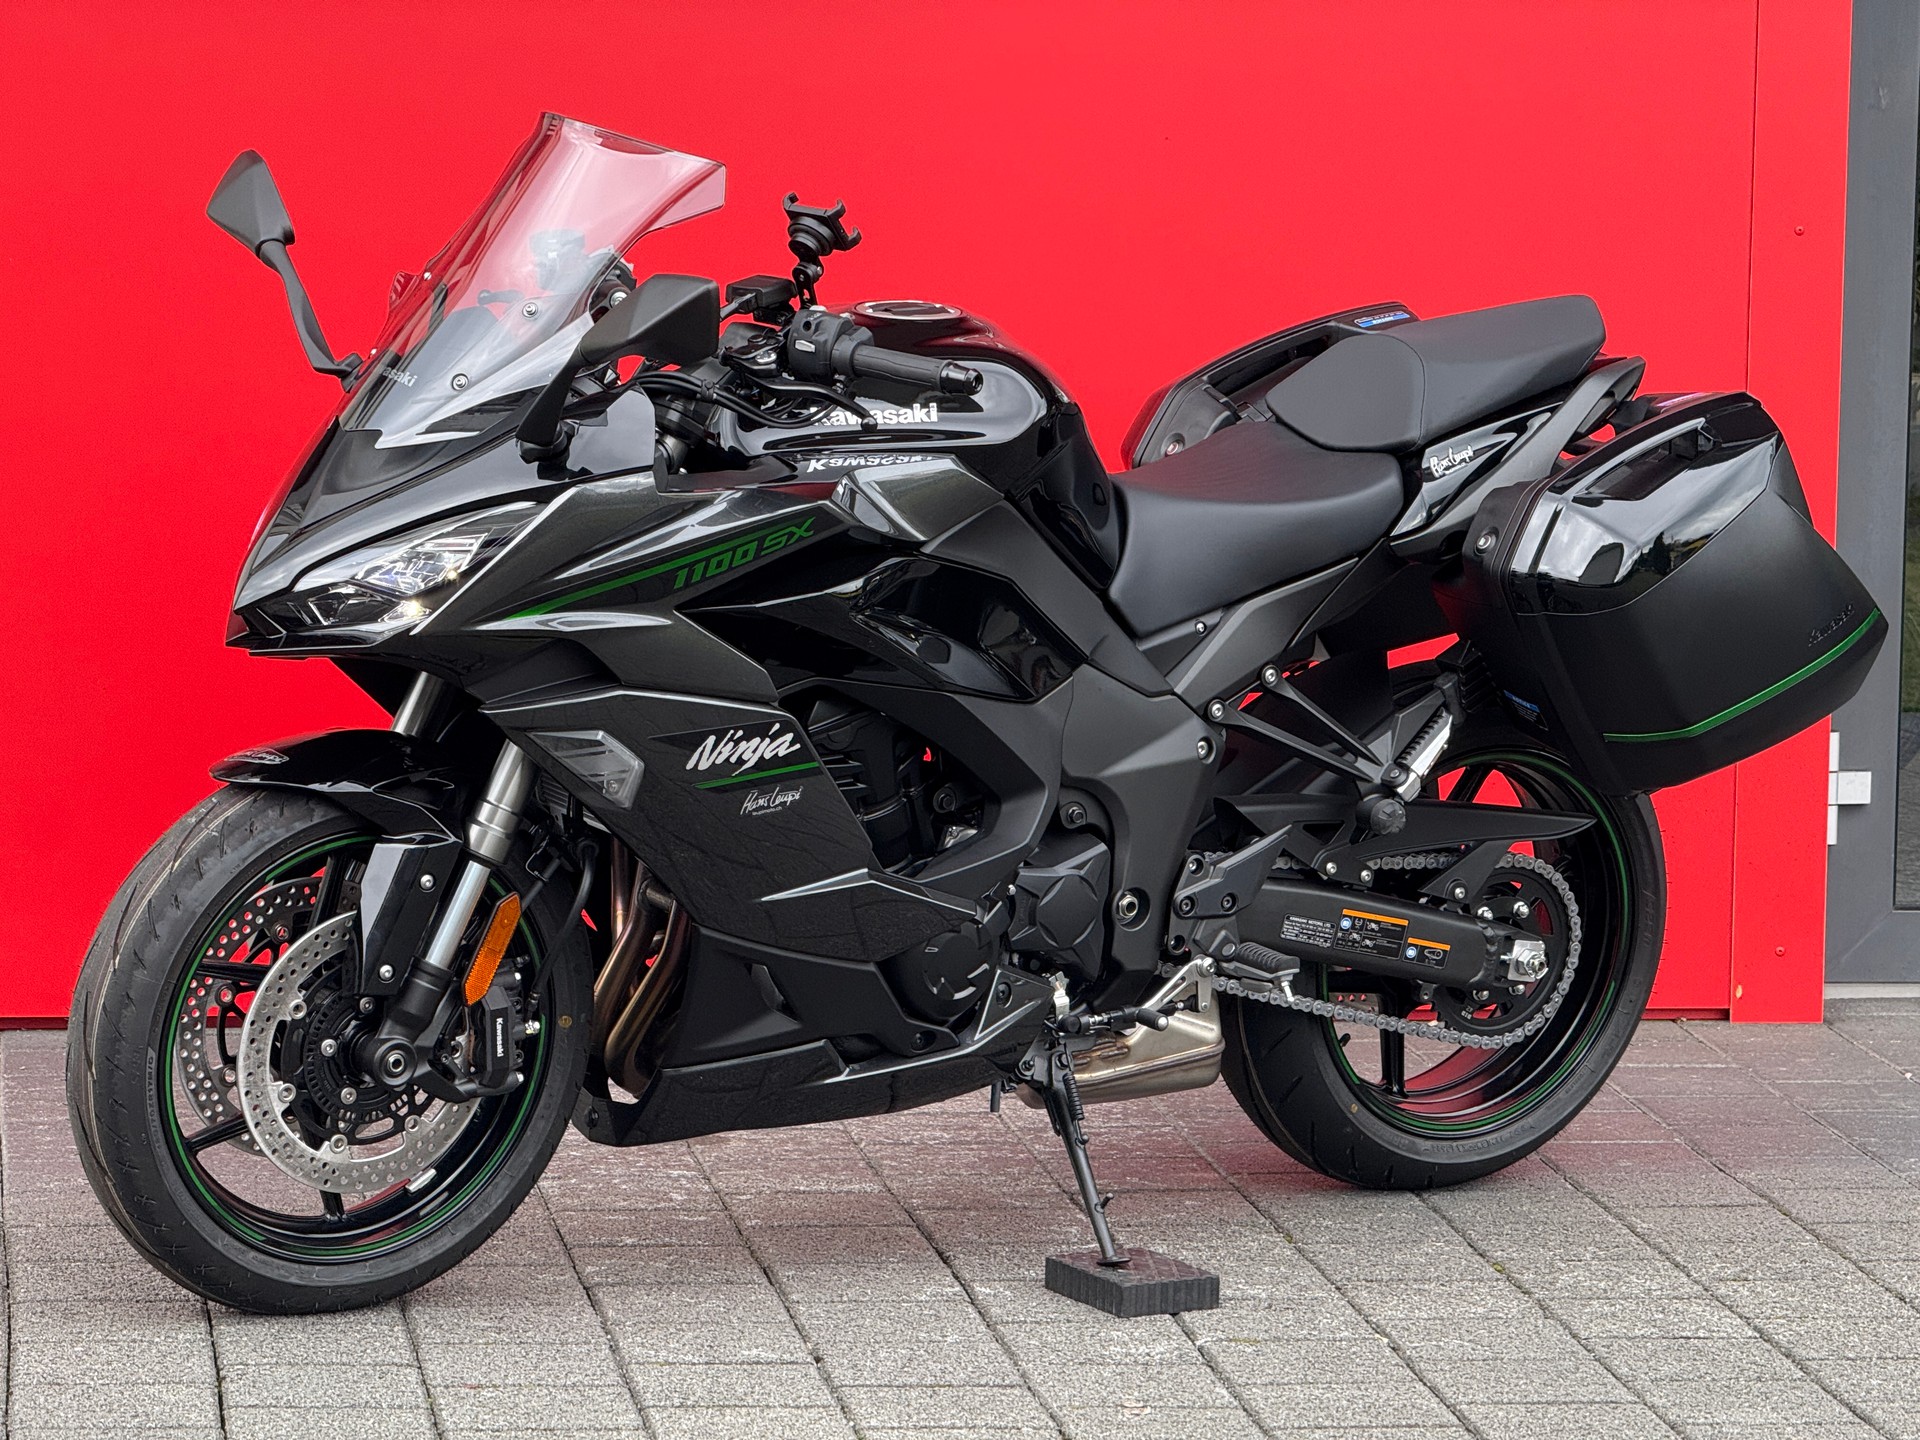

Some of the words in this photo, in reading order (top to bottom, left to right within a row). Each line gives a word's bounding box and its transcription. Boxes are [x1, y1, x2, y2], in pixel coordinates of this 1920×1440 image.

[685, 722, 801, 777] Ninja
[740, 789, 771, 815] Hans
[496, 1017, 504, 1058] Kawasaki
